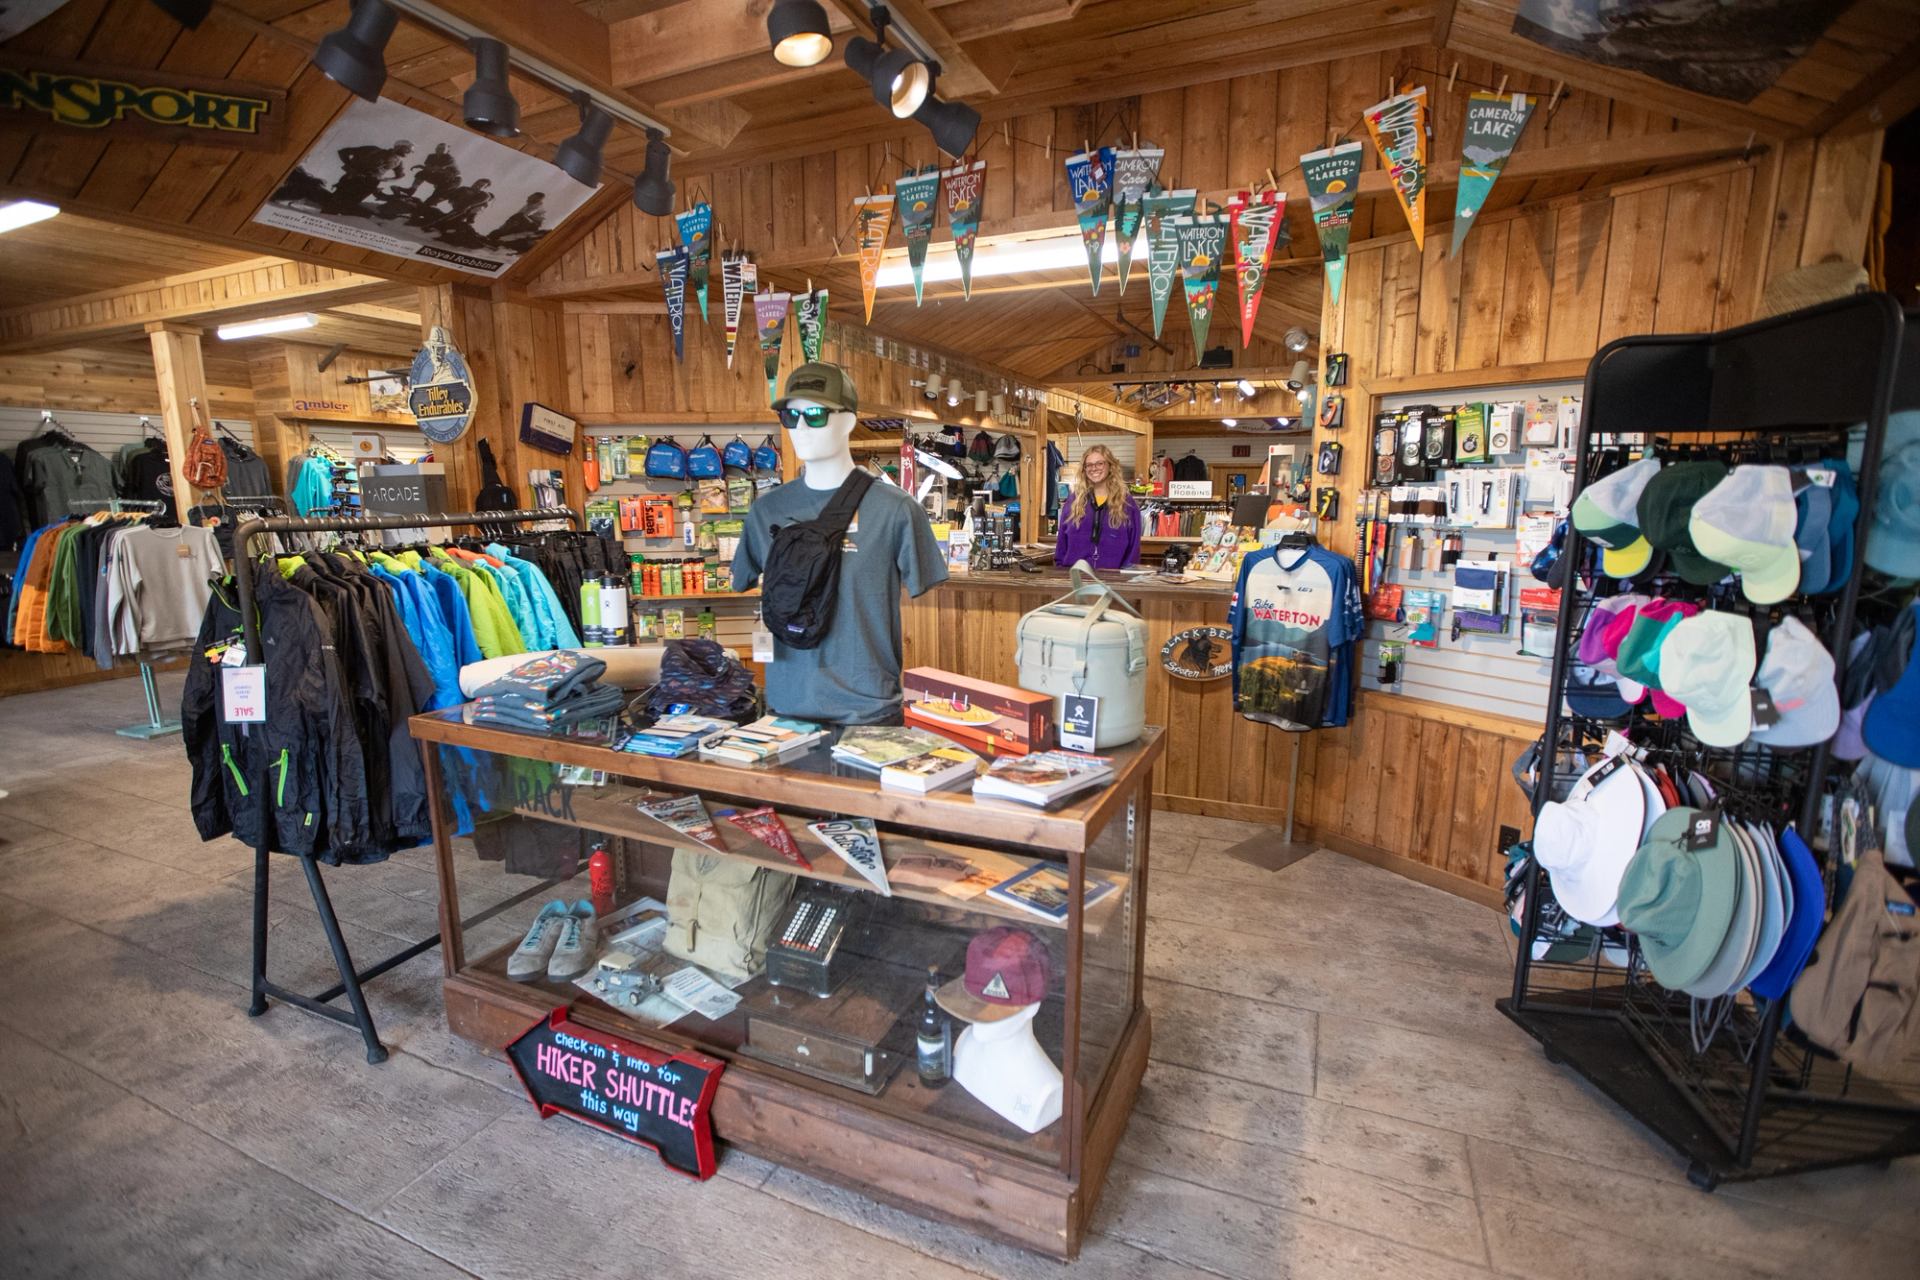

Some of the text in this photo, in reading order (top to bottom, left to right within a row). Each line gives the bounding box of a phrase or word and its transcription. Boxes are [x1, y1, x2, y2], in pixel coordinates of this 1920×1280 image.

[1470, 107, 1525, 125] CAMERON
[1472, 120, 1515, 138] LAKE
[1114, 157, 1159, 172] CAMERON
[1307, 159, 1357, 176] WATERTON
[945, 172, 982, 189] WATERTON
[1314, 168, 1350, 182] LAKES
[901, 184, 935, 196] WATERTON
[906, 192, 931, 202] LAKES
[1178, 225, 1225, 240] WATERTON
[421, 247, 499, 270] Royal Robbins
[1183, 238, 1220, 262] LAKES
[761, 309, 782, 319] LAKES
[1194, 307, 1208, 320] NP
[426, 386, 450, 402] Tilley
[417, 399, 464, 418] Endurables
[372, 486, 421, 502] ARCADE
[1252, 598, 1275, 611] Bike
[1253, 608, 1321, 626] WATERTON
[1161, 629, 1200, 654] BLACK
[1164, 661, 1200, 678] Spoken
[234, 707, 254, 716] SALE
[555, 1032, 605, 1059] check-in
[537, 1043, 596, 1090] HIKER
[581, 1090, 639, 1131] this way
